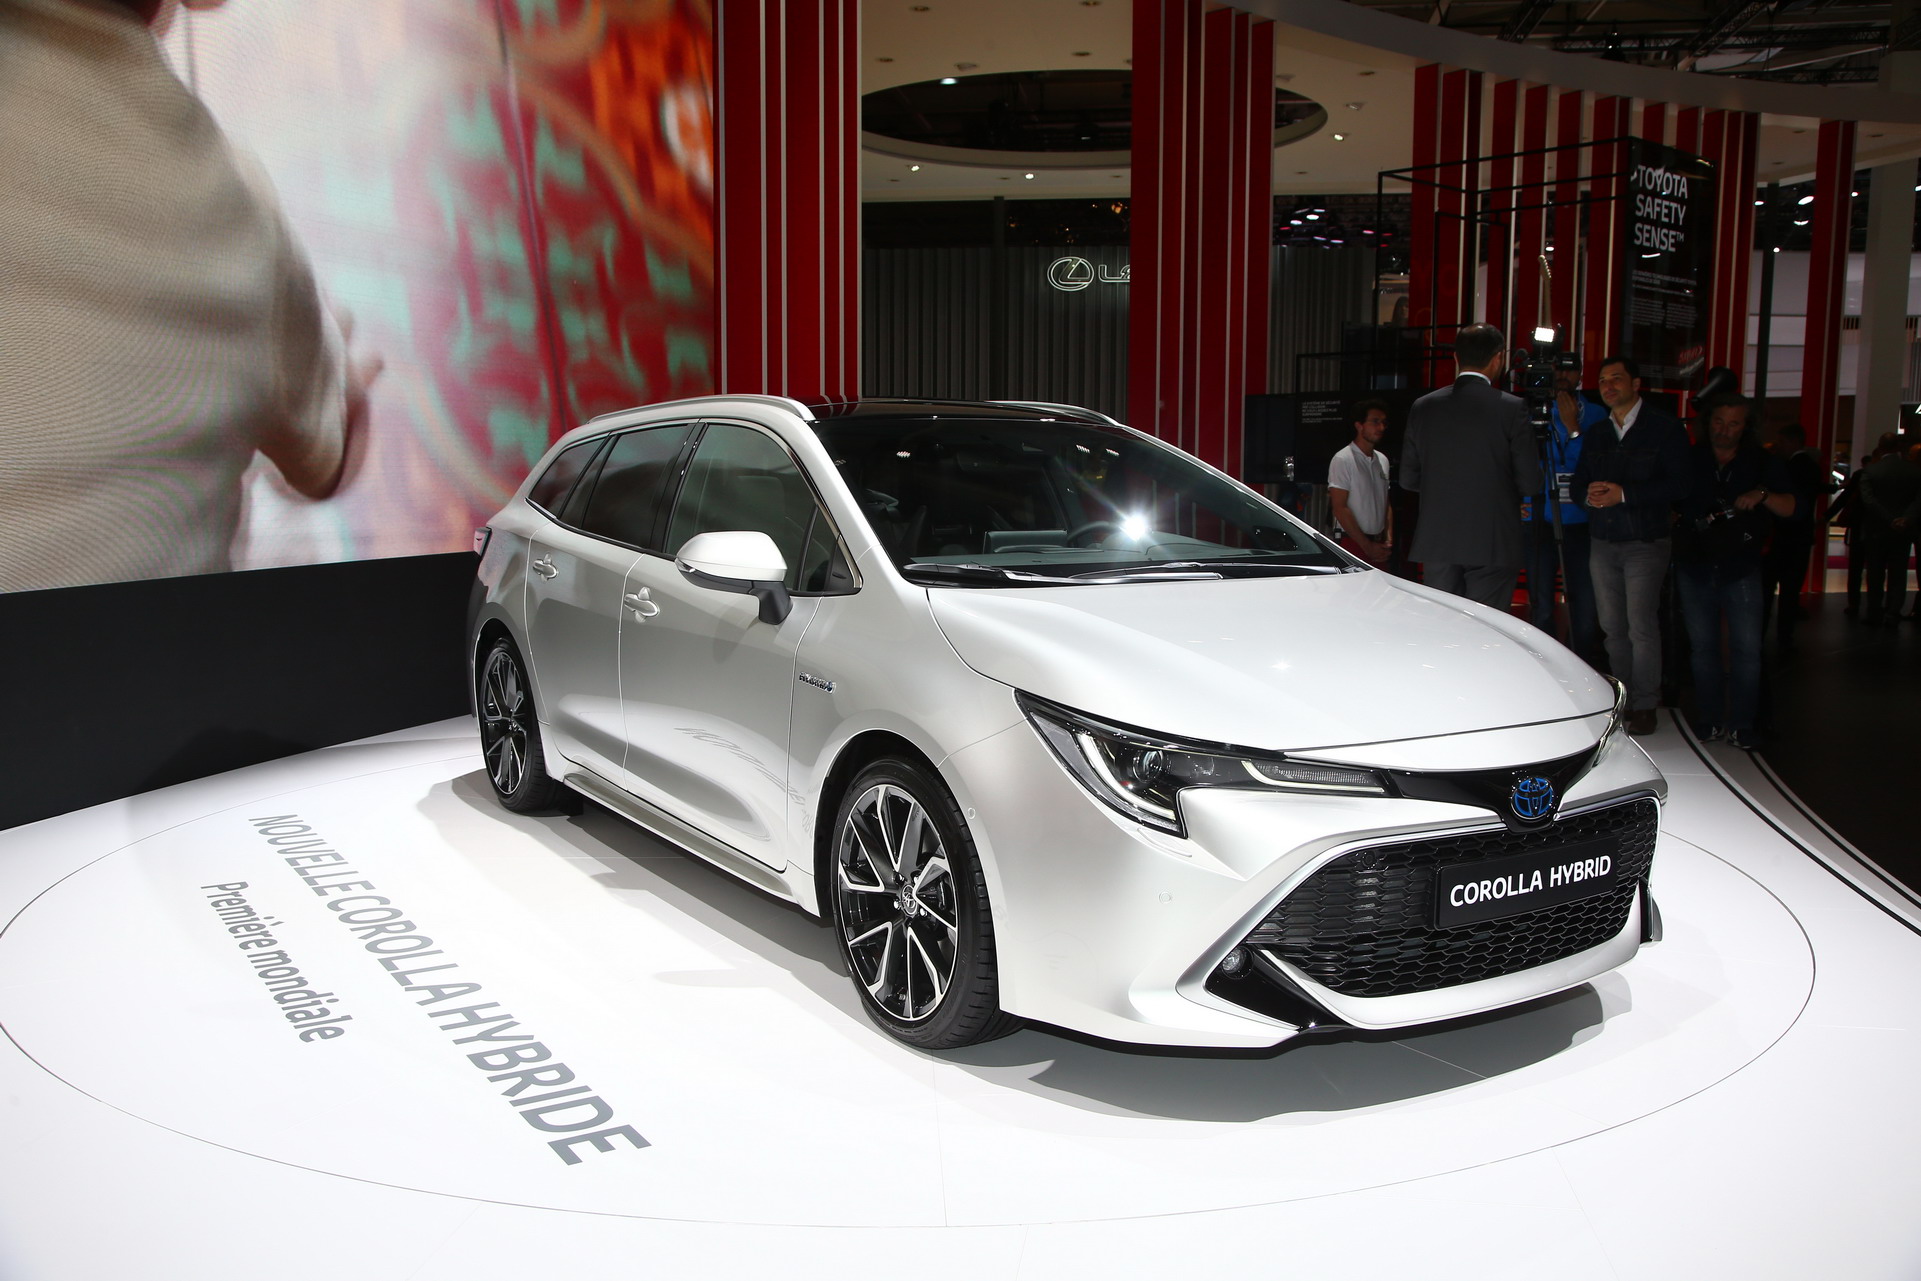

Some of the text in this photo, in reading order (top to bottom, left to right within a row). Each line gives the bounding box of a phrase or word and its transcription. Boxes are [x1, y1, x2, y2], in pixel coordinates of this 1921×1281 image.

[1638, 165, 1688, 199] TOYOTA
[1635, 194, 1686, 226] SAFETY
[1450, 855, 1612, 907] COROLLA HYBRID
[200, 881, 353, 1043] Première mondiale
[249, 814, 652, 1166] NOUVELLE COROLLA HYBRIDE
